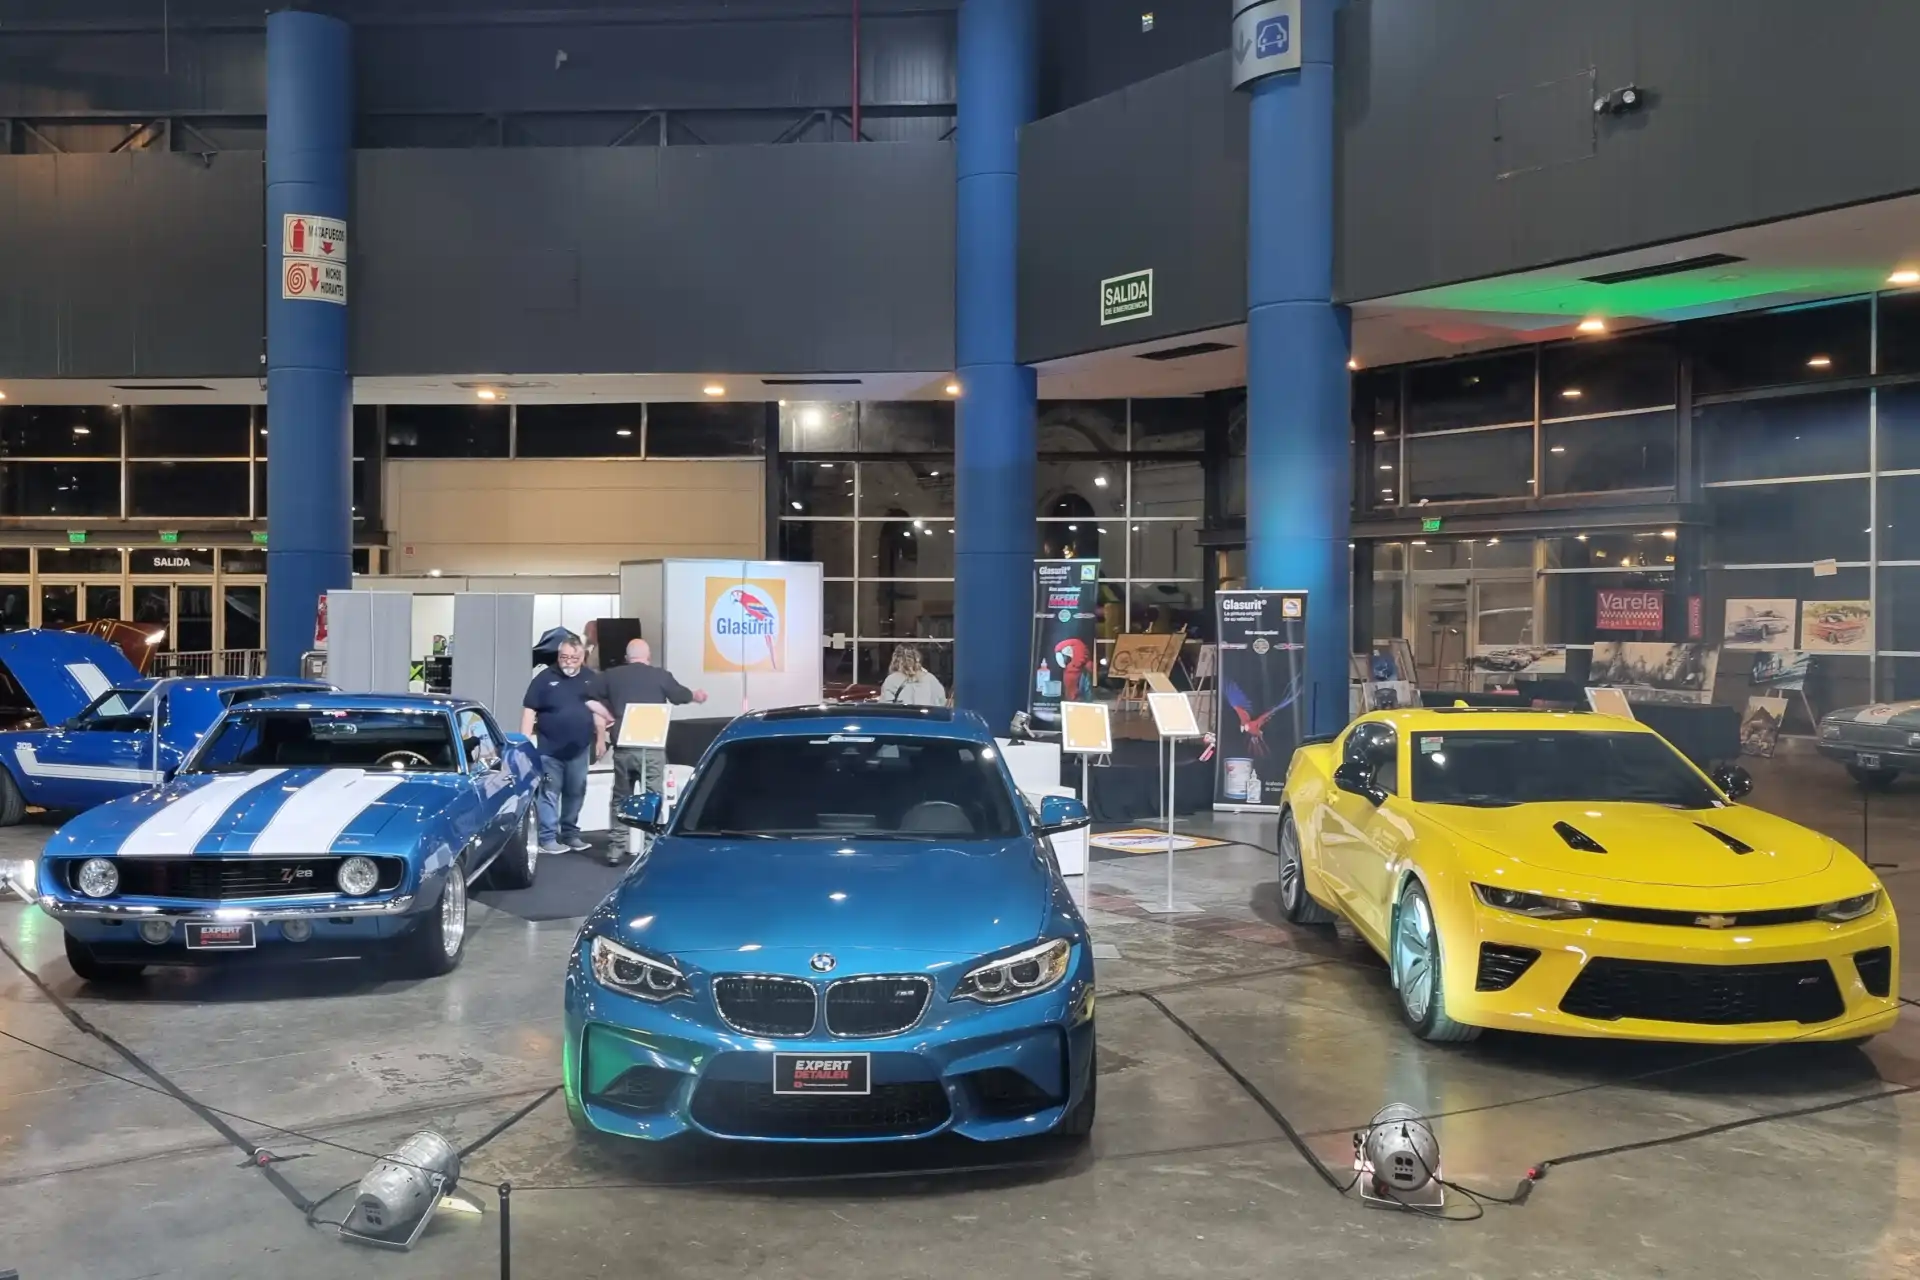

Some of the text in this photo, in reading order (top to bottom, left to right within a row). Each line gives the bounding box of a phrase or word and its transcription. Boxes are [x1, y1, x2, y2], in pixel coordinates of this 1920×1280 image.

[1105, 280, 1148, 306] SALIDA
[1105, 307, 1113, 316] DE
[153, 557, 191, 567] SALIDA
[1599, 592, 1660, 610] Varela
[716, 617, 774, 635] Glasurit
[200, 926, 242, 934] EXPERT
[795, 1060, 852, 1071] EXPERT
[793, 1070, 849, 1079] DETAILER
